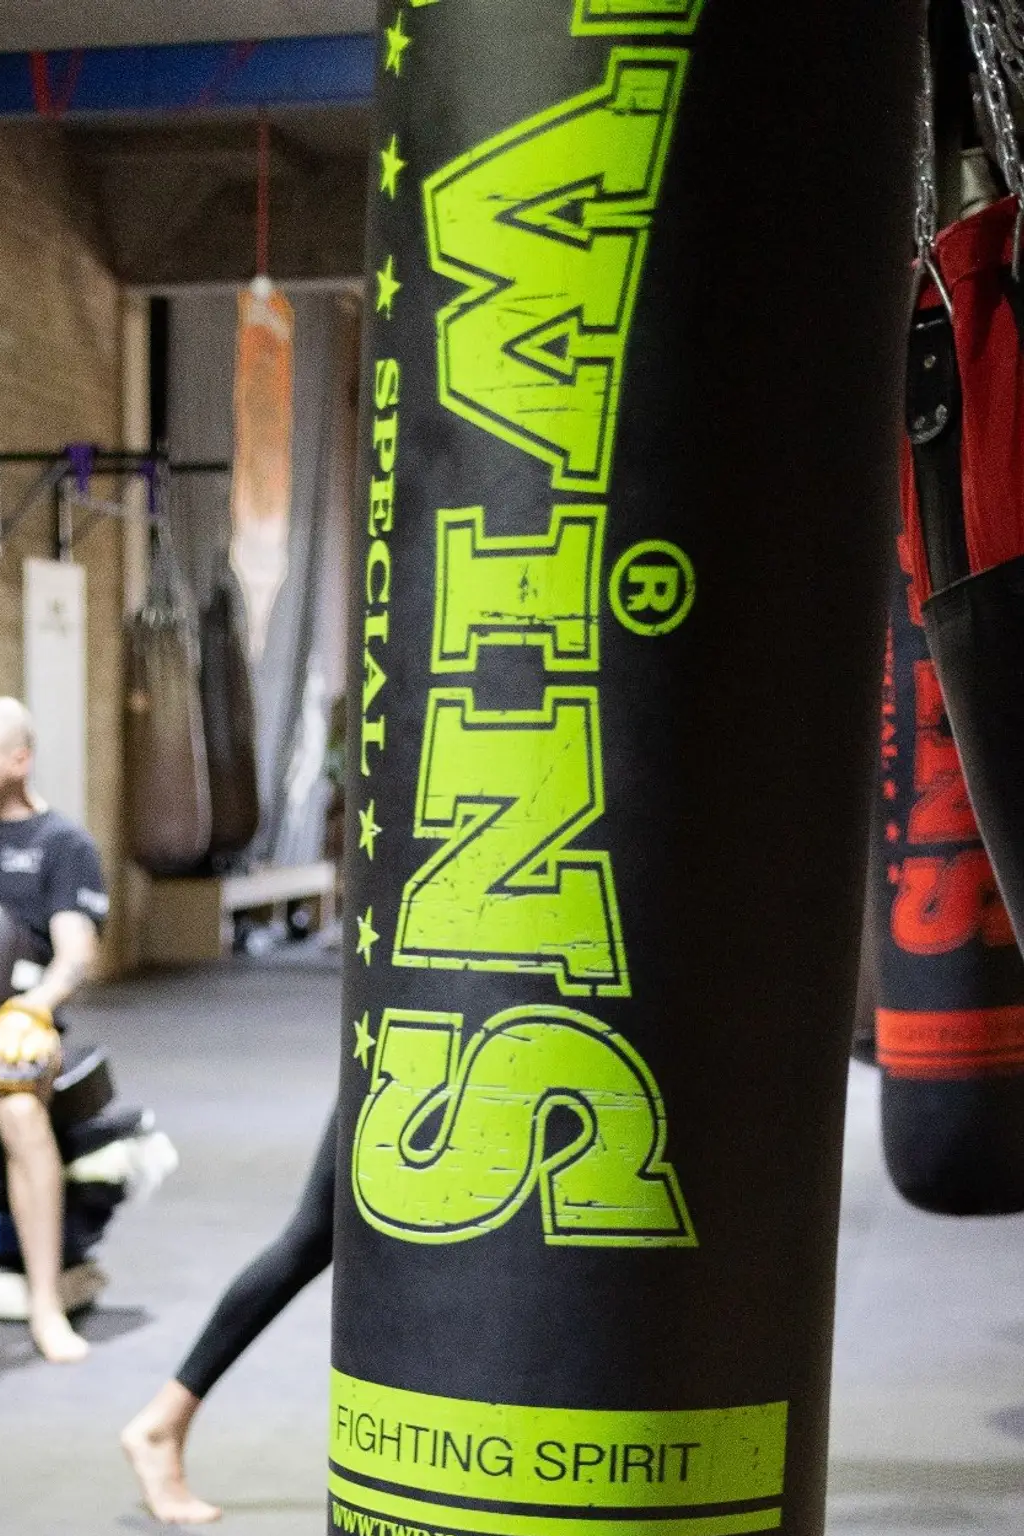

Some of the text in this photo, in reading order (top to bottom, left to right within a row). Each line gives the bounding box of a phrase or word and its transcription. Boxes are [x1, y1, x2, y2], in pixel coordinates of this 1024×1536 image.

[351, 0, 706, 1248] WINS
[360, 358, 400, 777] SPECIAL
[337, 1404, 703, 1483] FIGHTING SPIRIT
